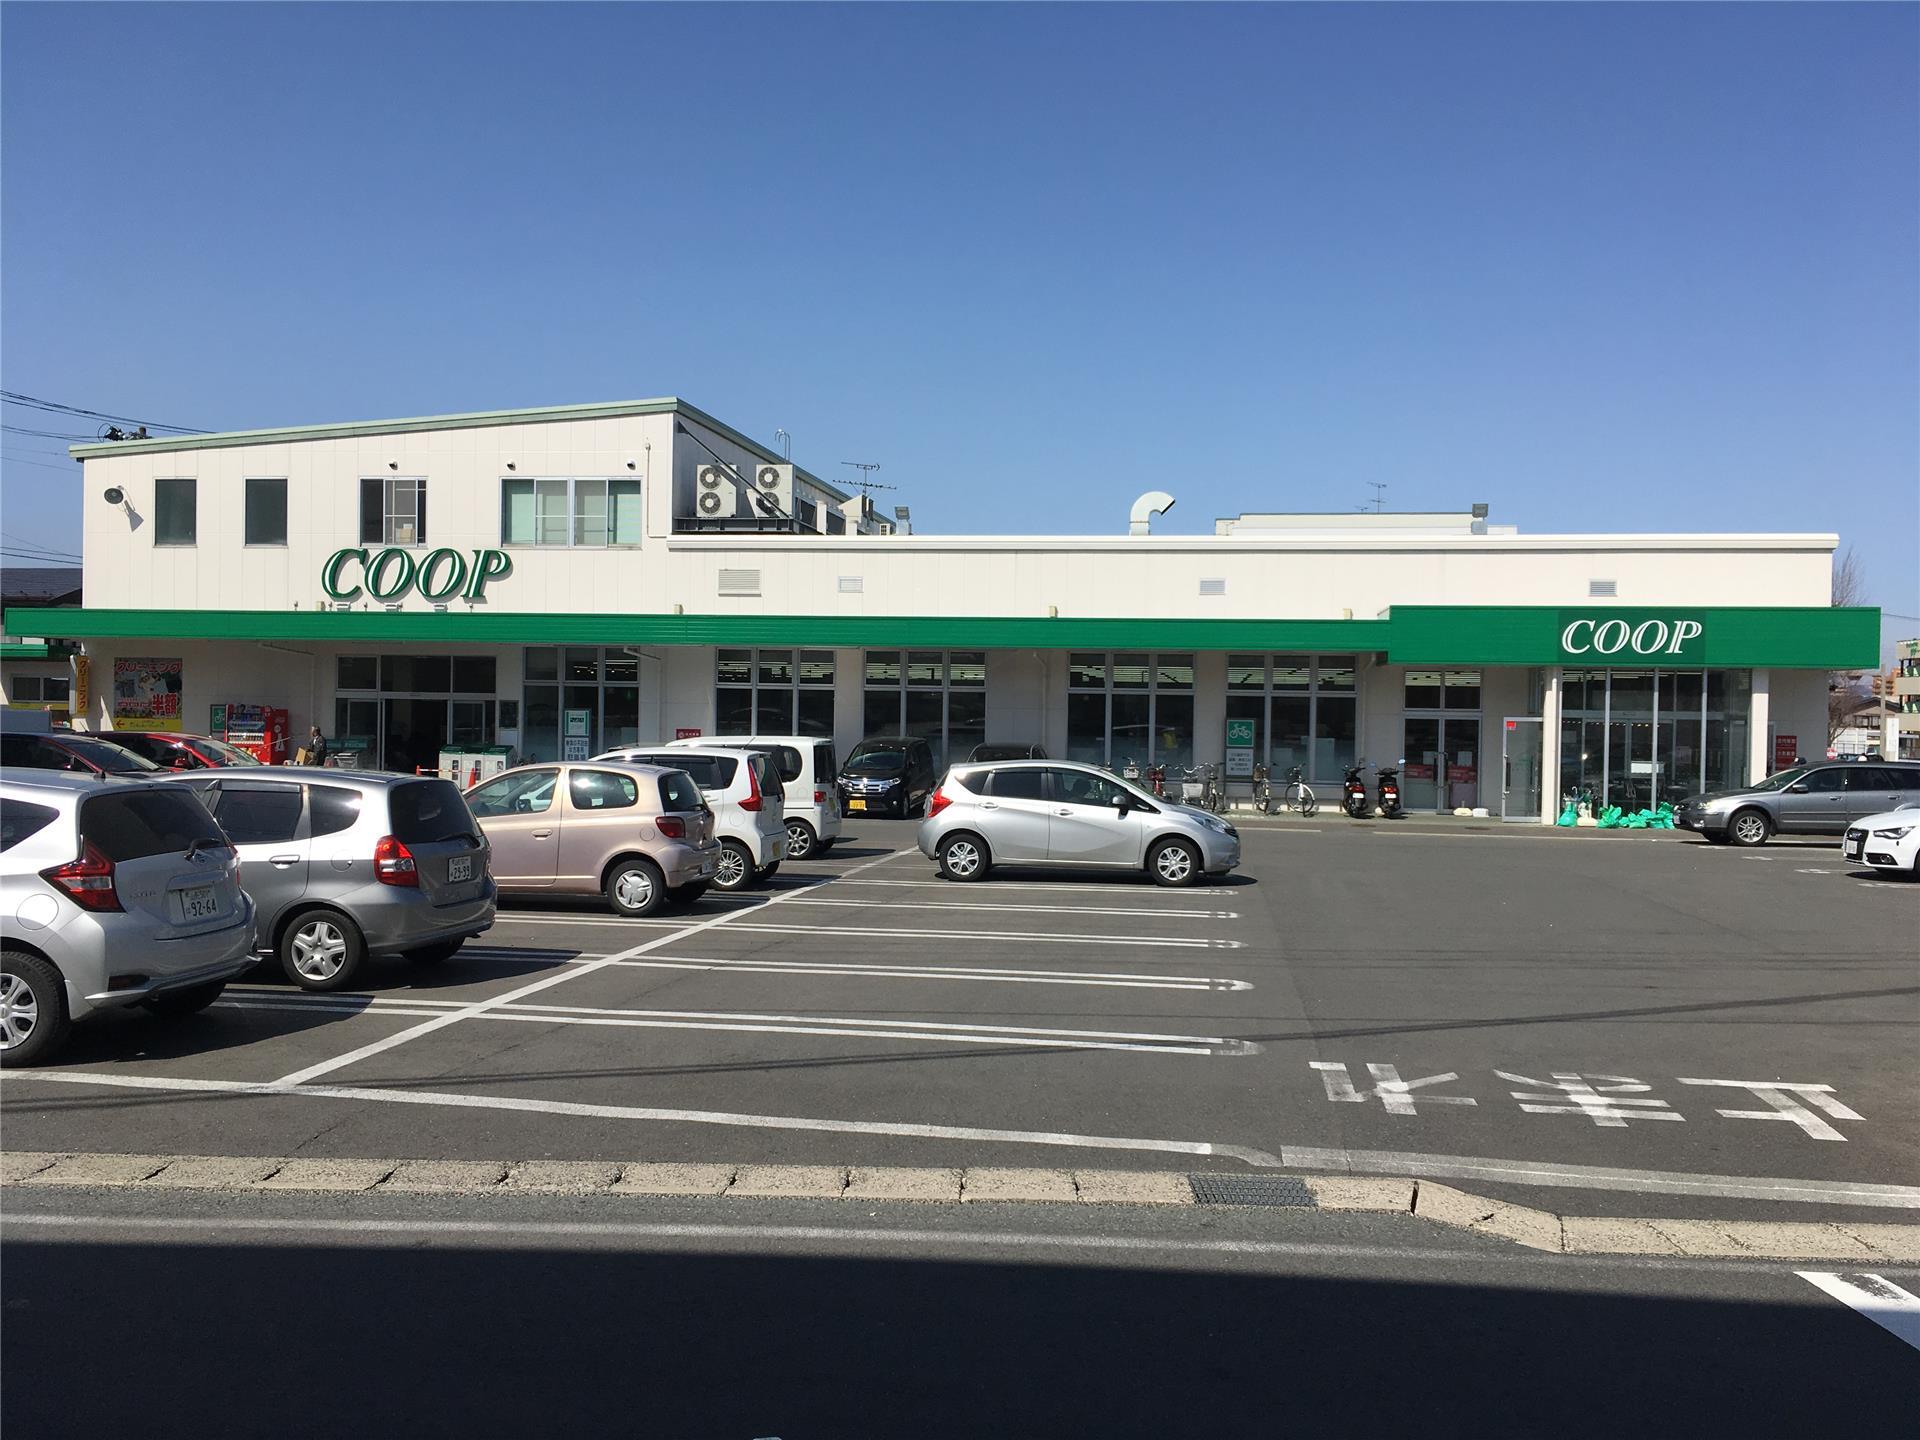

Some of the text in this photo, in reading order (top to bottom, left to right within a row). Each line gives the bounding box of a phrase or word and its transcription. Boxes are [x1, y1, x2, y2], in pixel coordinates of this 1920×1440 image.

[321, 548, 513, 600] COOP
[1562, 619, 1703, 654] COOP
[115, 661, 182, 673] クリーニング
[79, 659, 88, 709] クリーニング
[152, 692, 177, 716] 半額
[190, 898, 217, 917] 92-64
